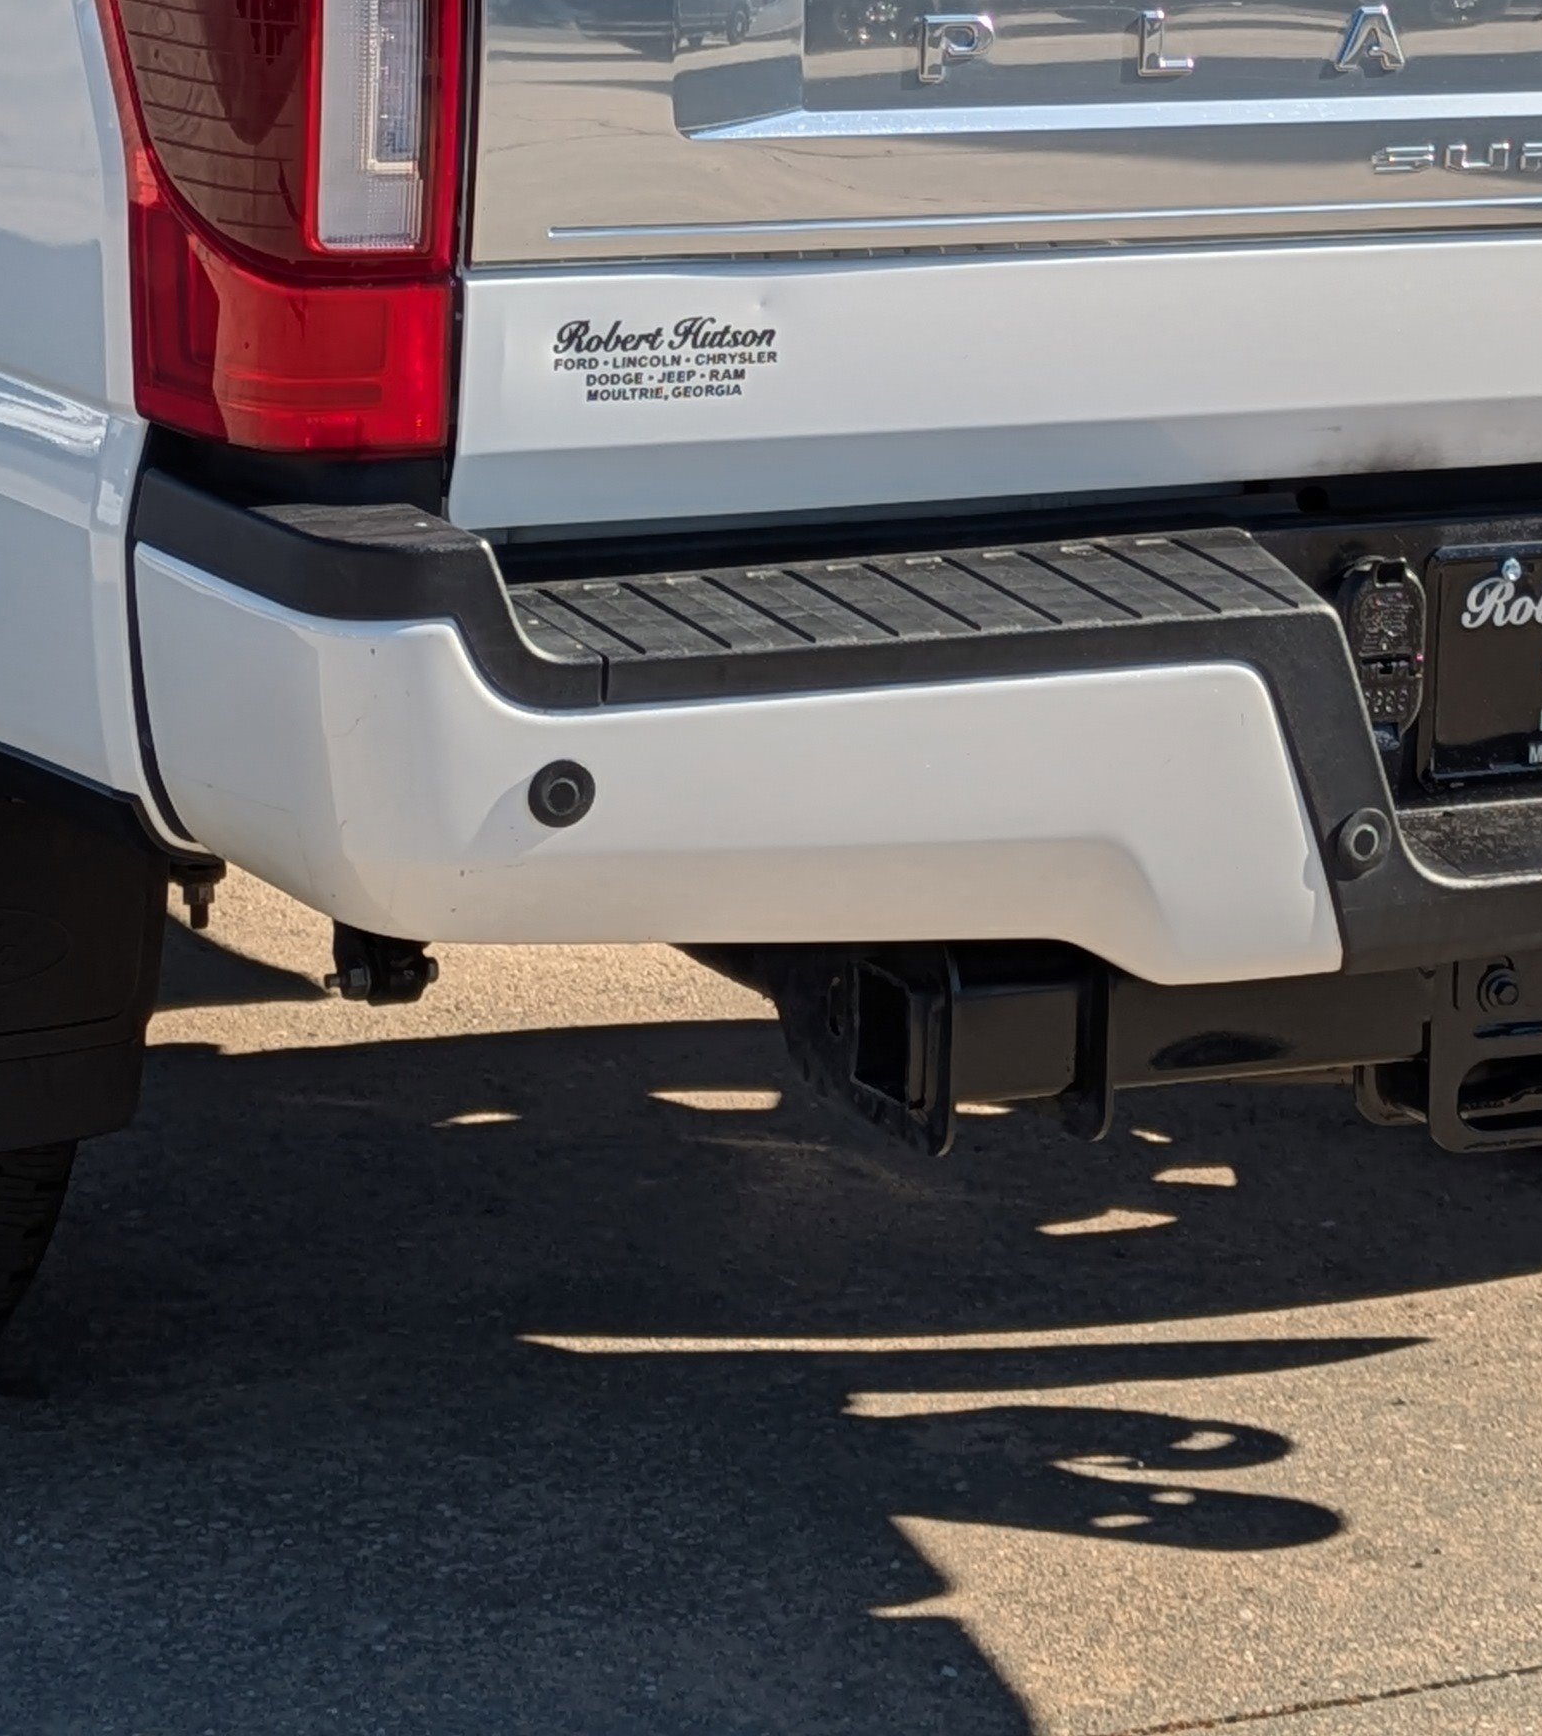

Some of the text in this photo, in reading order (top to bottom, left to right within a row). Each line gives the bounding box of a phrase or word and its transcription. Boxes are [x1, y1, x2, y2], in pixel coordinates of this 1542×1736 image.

[553, 315, 777, 354] Robert Hutson
[553, 350, 778, 372] FORD LINCOLN CHRYSLER
[585, 367, 746, 387] DODGE JEEP RAM
[585, 383, 743, 402] MOULTRIE, GEORGIA
